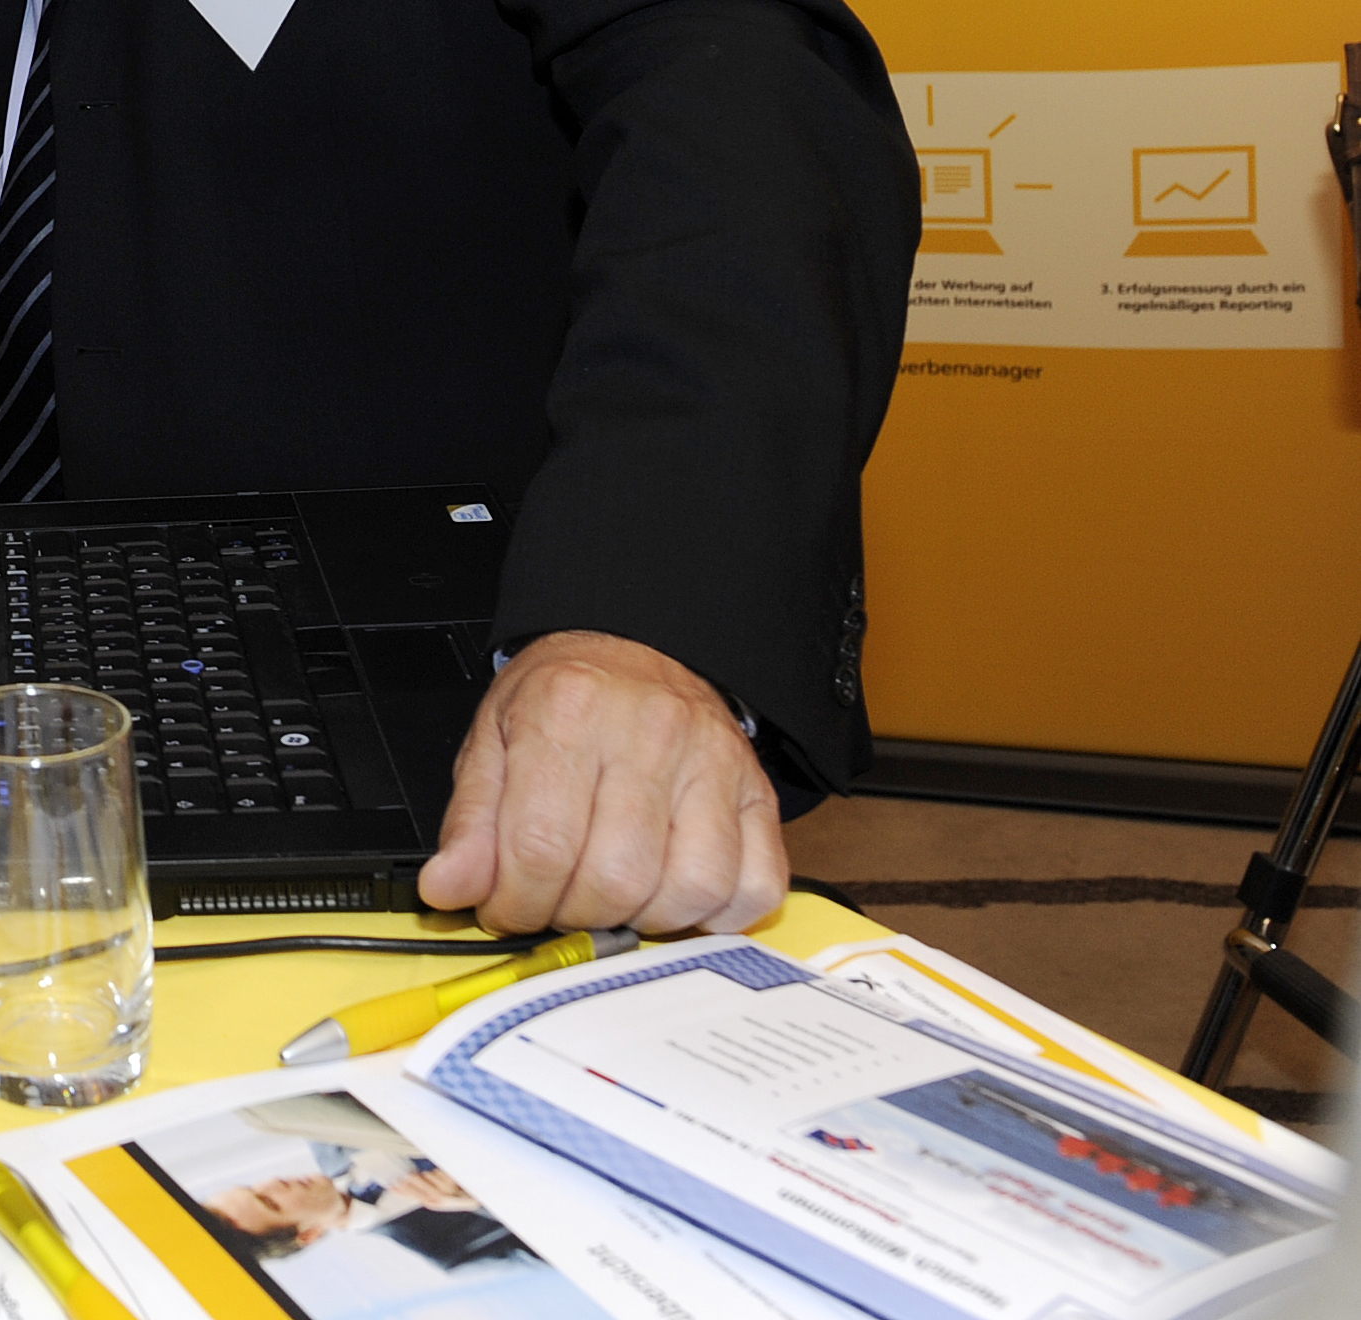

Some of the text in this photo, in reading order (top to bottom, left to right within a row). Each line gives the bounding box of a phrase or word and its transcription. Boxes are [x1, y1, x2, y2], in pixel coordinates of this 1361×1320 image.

[914, 279, 1033, 294] der Werbung auf
[1117, 283, 1232, 296] Erfolgsmessung
[1236, 282, 1278, 294] durch
[1282, 282, 1306, 293] ein
[954, 297, 1052, 309] Internetseiten
[1219, 299, 1293, 312] Reporting
